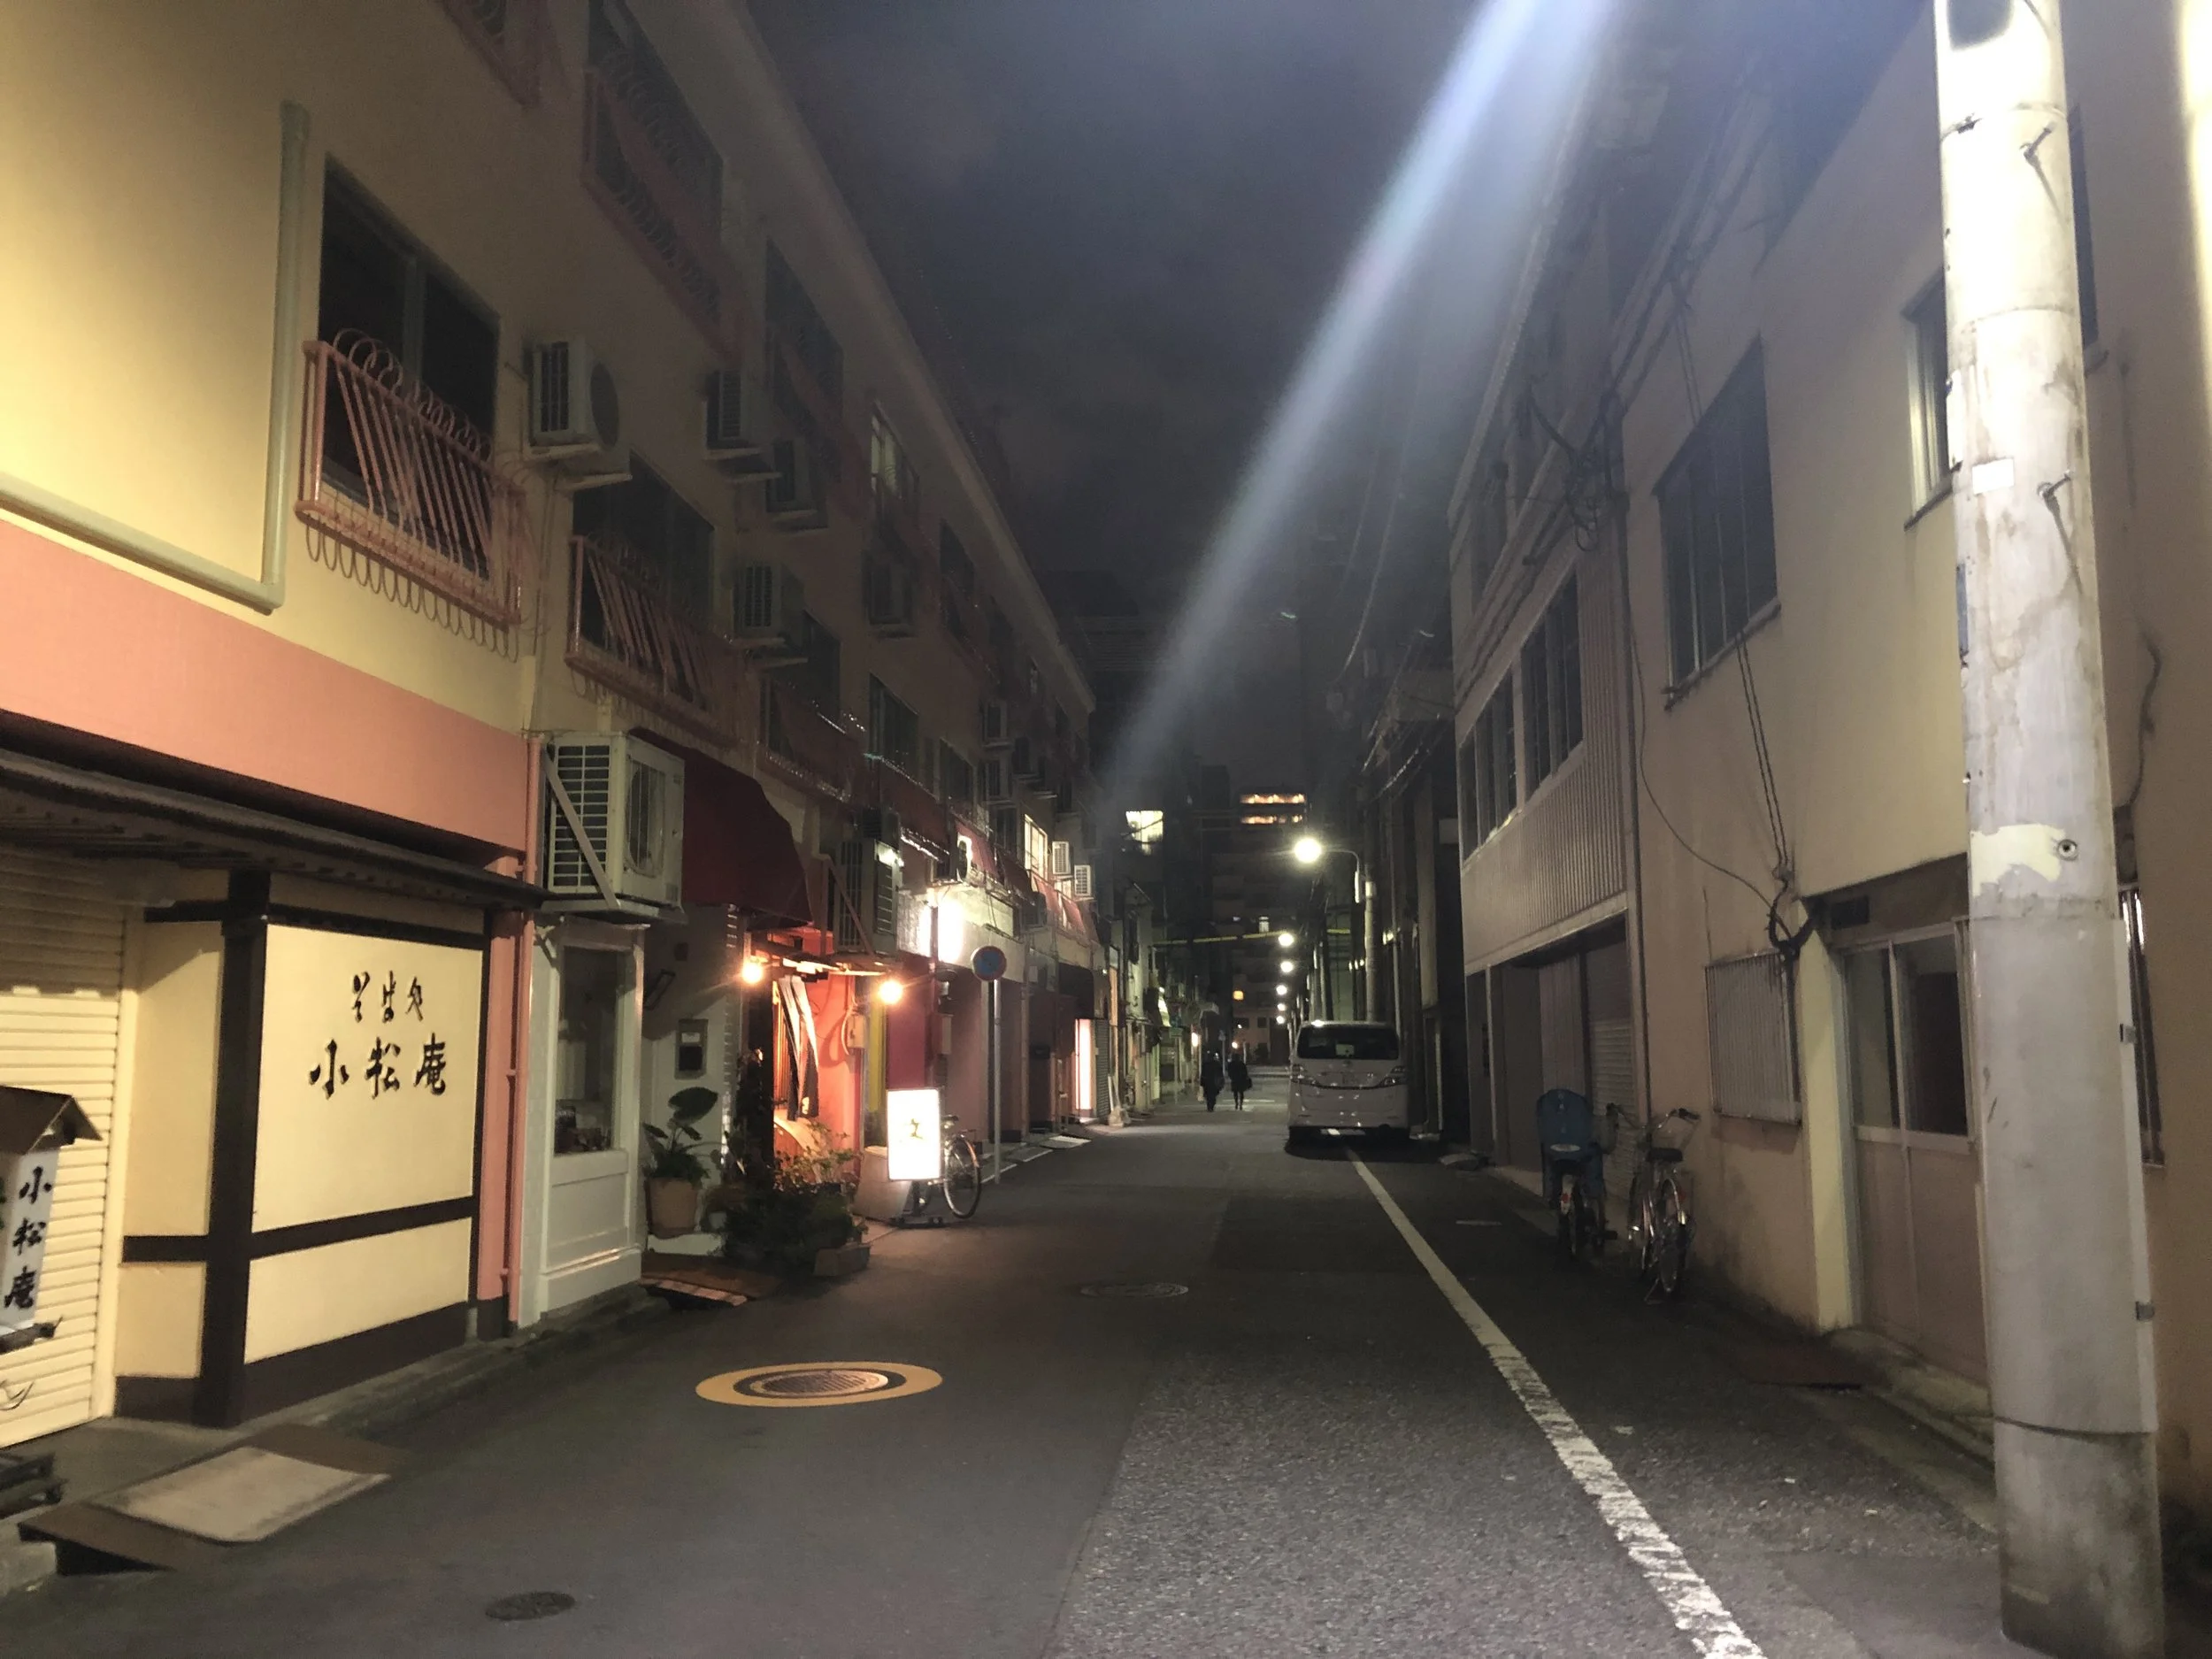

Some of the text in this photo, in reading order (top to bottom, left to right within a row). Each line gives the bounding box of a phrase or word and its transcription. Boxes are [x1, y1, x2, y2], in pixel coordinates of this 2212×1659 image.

[309, 1033, 447, 1100] 小松庵
[4, 1165, 53, 1310] 小松庵
